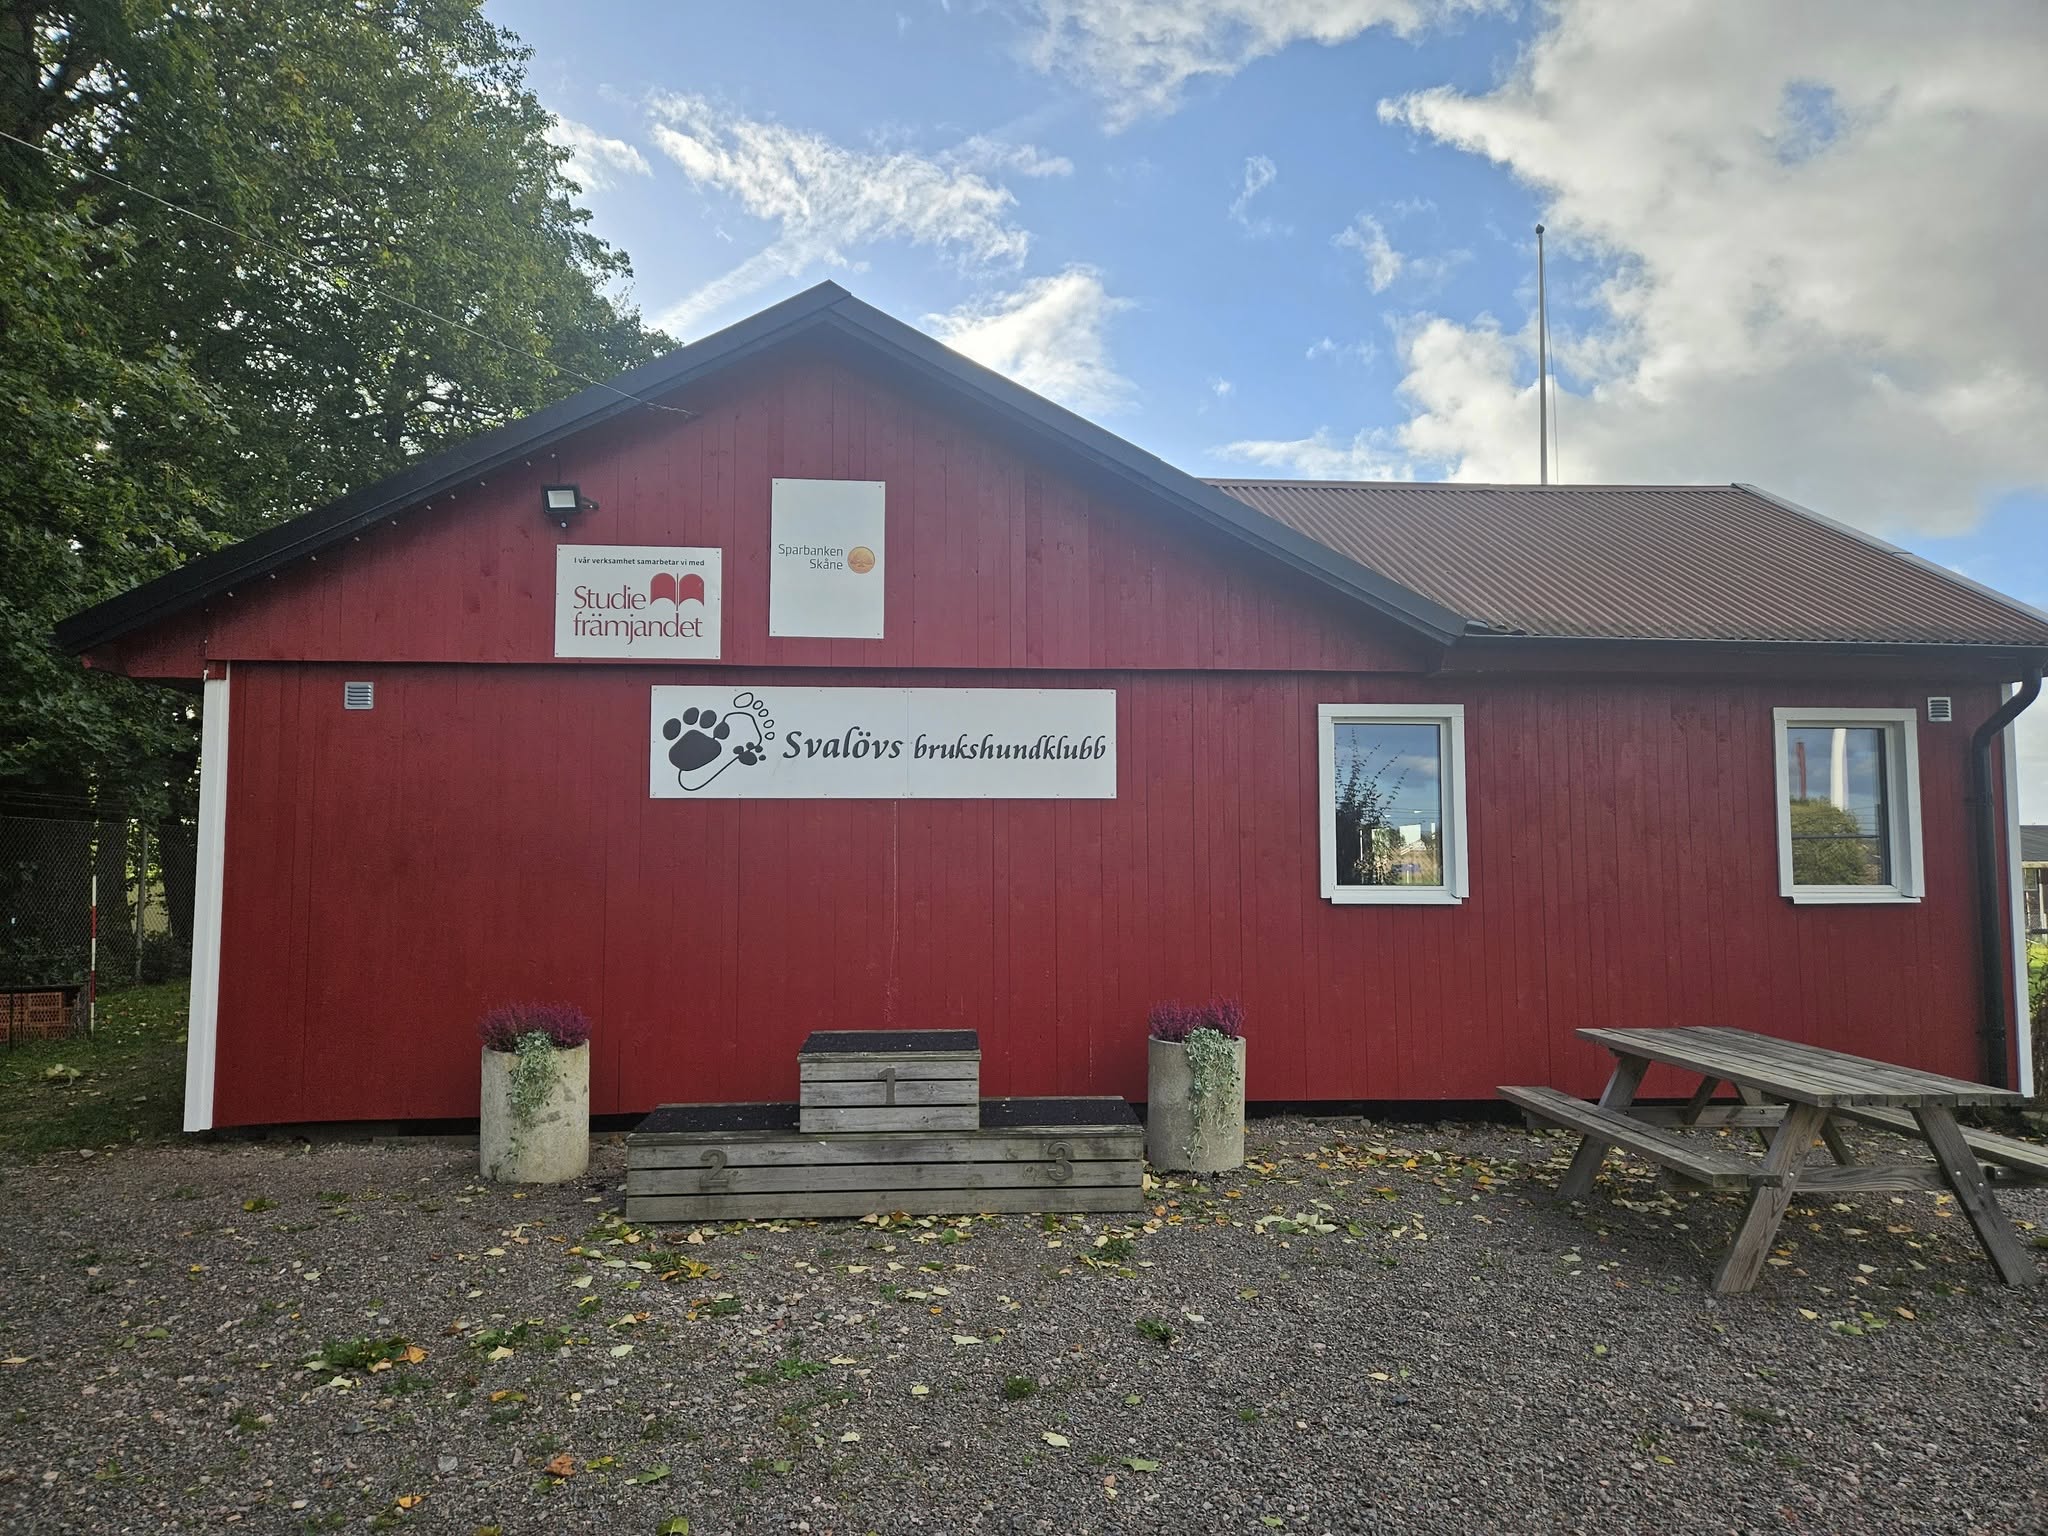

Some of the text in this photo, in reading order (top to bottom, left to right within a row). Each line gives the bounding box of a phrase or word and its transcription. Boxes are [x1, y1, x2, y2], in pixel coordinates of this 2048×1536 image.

[592, 557, 635, 565] verksamhet
[637, 558, 679, 566] samarbetar
[778, 543, 843, 557] Sparbanken
[809, 558, 843, 570] Skåne
[573, 585, 647, 610] Studie
[573, 611, 704, 645] främjandet
[782, 726, 1107, 761] Svalövs brukshundklubb
[877, 1067, 897, 1104] 1
[699, 1148, 729, 1188] 2
[1046, 1141, 1074, 1182] 3
